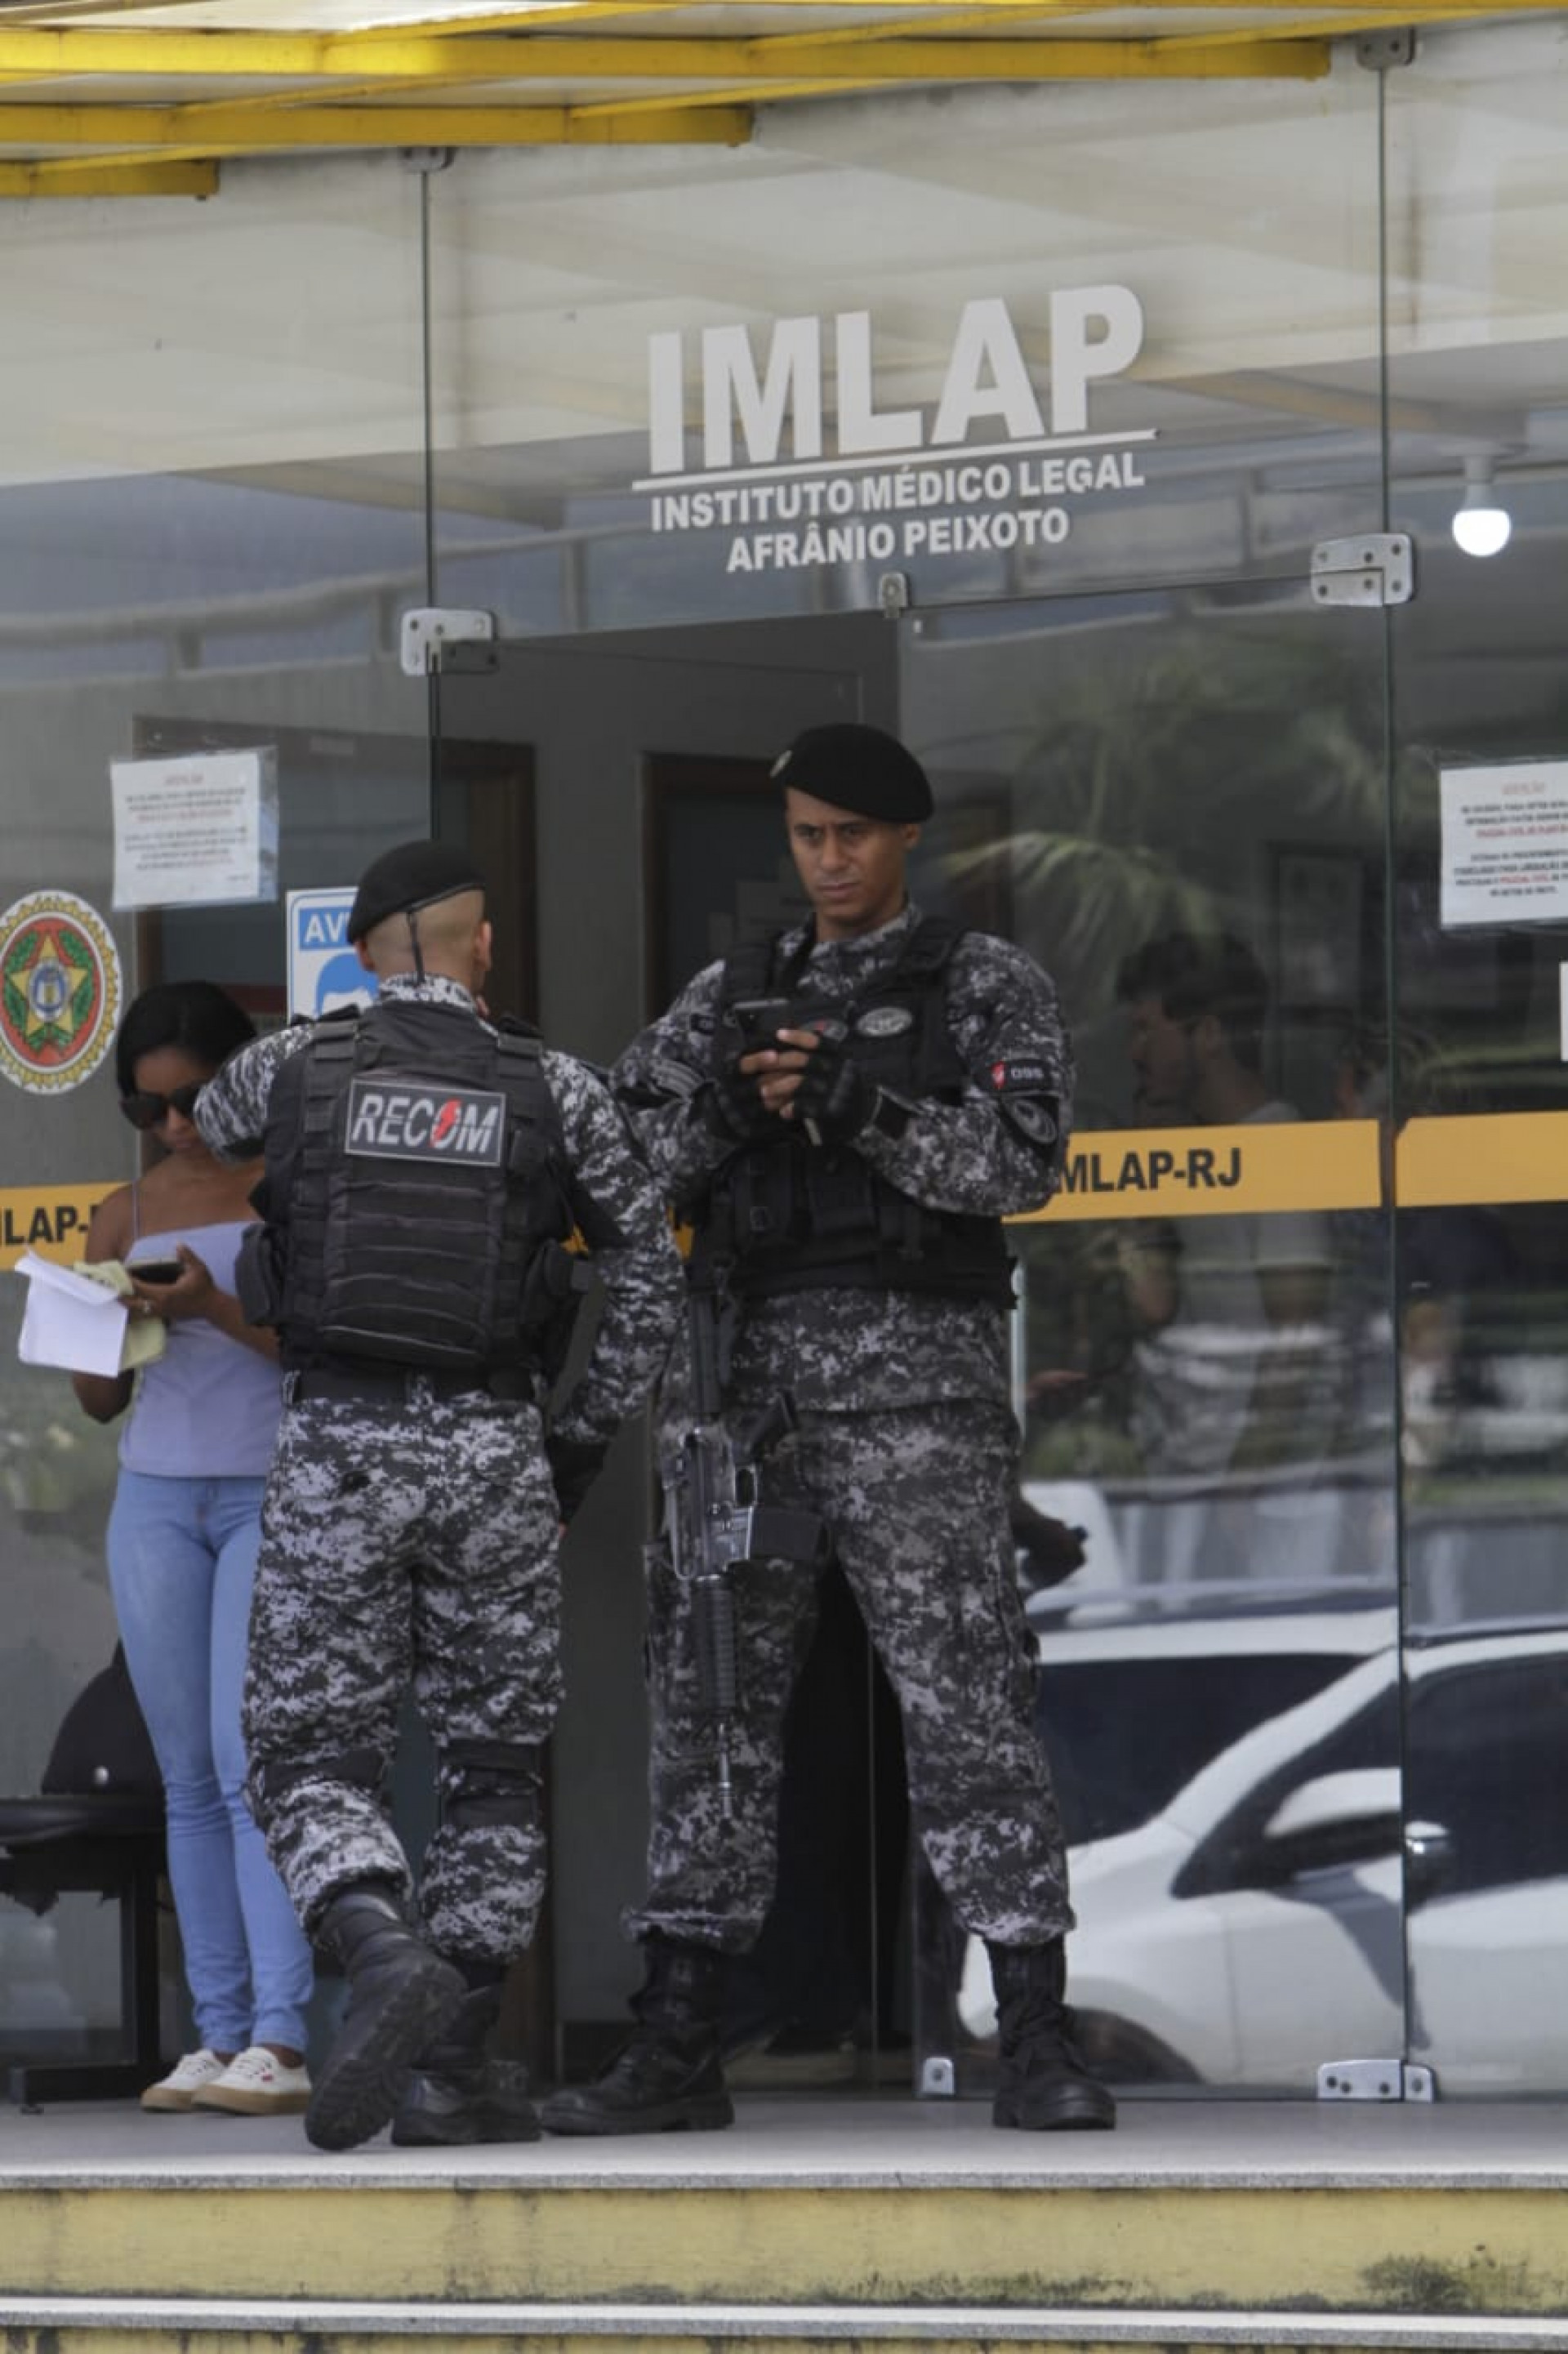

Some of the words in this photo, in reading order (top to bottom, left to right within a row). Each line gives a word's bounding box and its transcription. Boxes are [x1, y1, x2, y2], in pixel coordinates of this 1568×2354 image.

[649, 284, 1143, 474] IMLAP
[652, 479, 853, 532] INSTITUTO
[862, 464, 1011, 511] MÉDICO
[1018, 452, 1145, 497] LEGAL
[727, 522, 895, 573] AFRÂNIO
[903, 507, 1069, 556] PEIXOTO
[351, 1094, 499, 1154] RECOM
